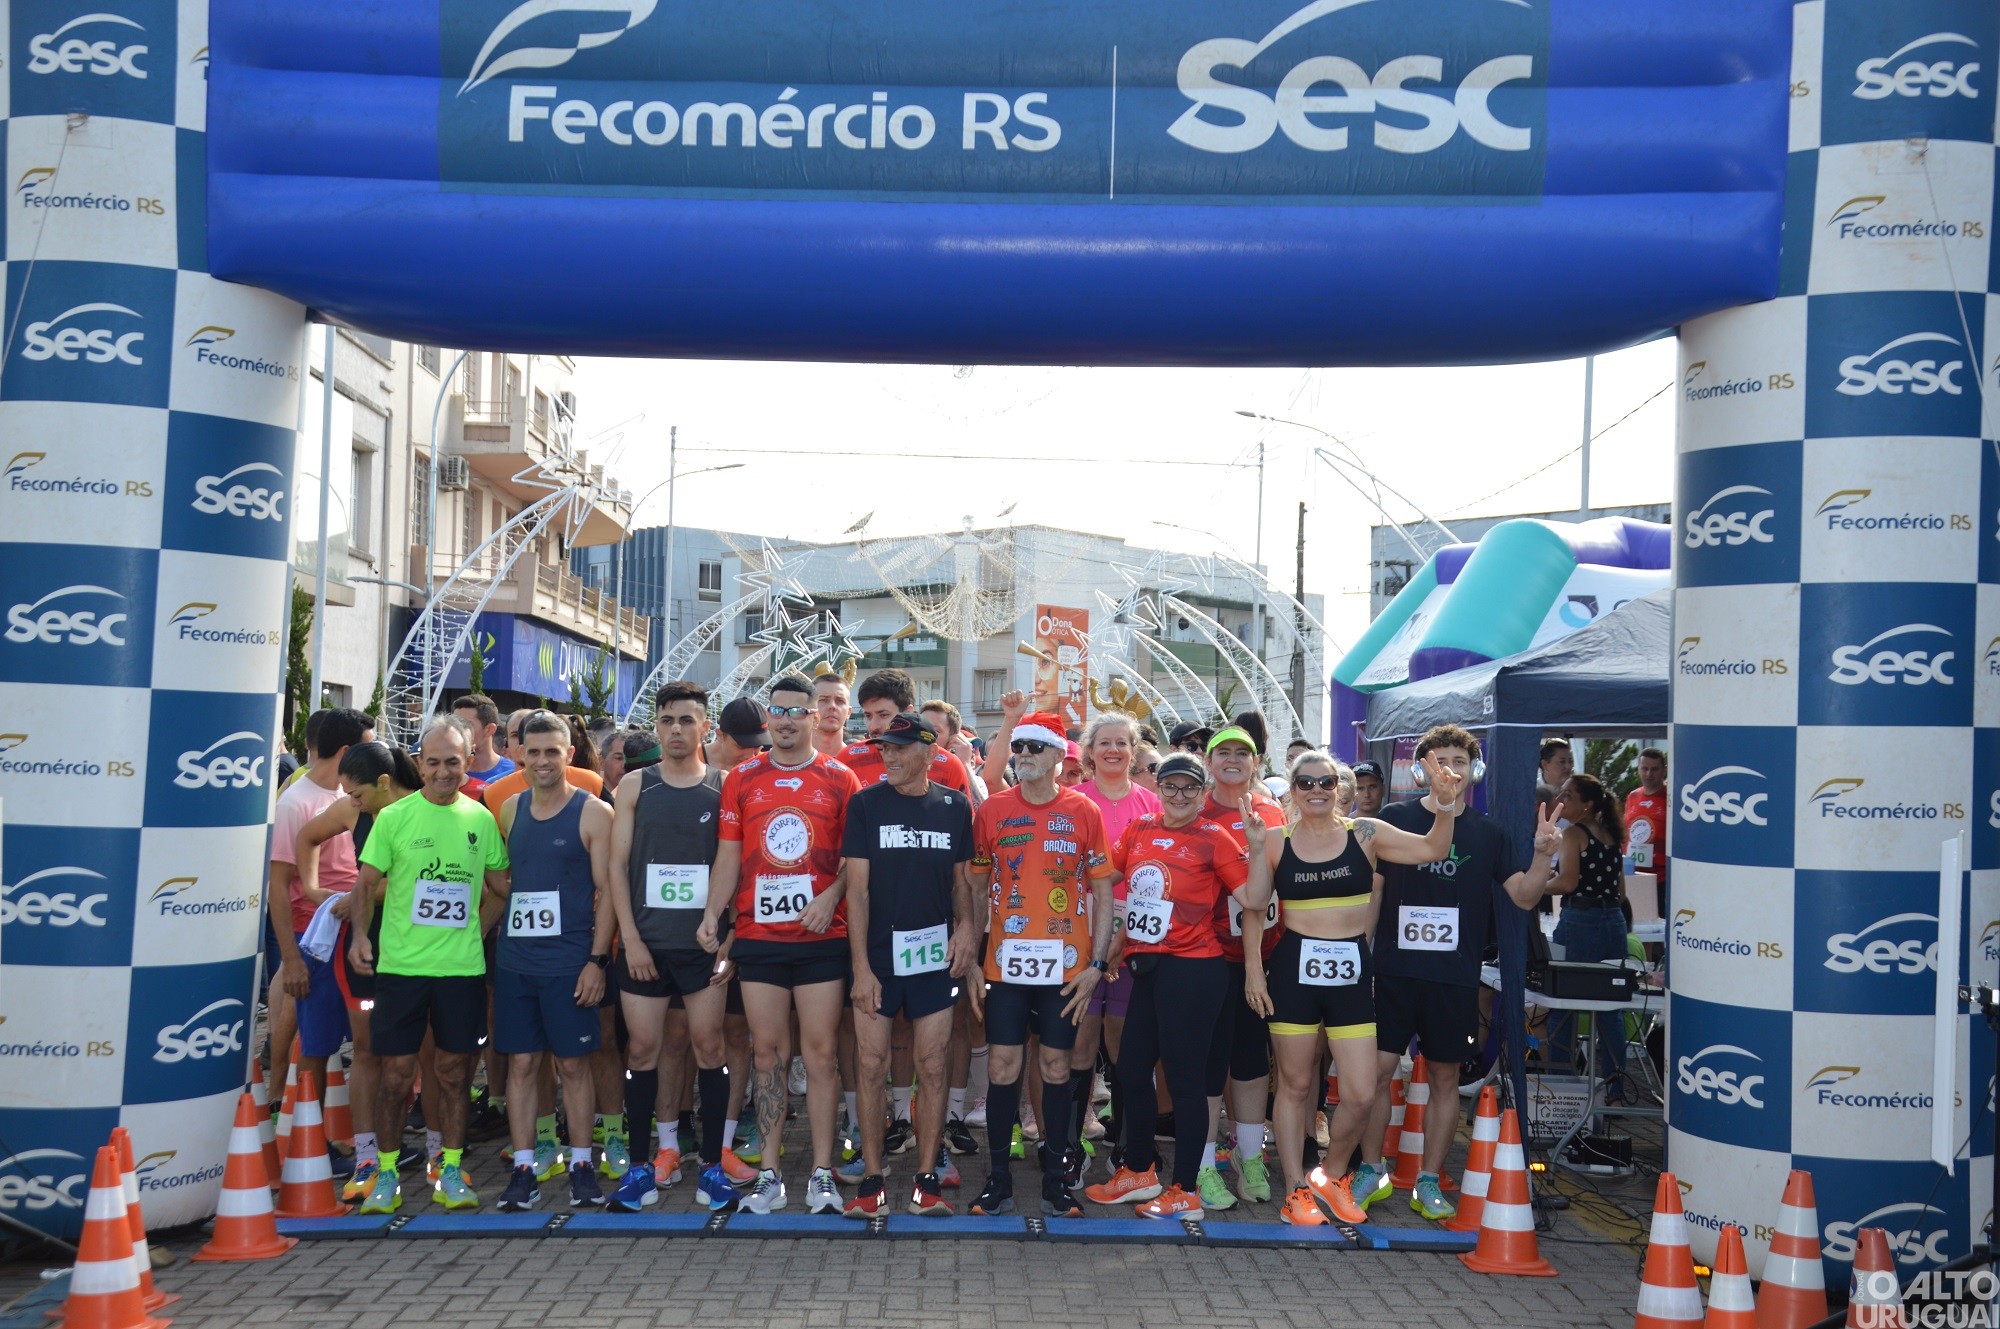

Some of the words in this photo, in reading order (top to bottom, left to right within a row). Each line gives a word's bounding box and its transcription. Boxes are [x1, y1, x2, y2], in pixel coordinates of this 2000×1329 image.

[508, 84, 936, 151] Fecomércio
[962, 91, 1062, 152] RS
[24, 192, 131, 212] Fecomércio
[137, 197, 165, 216] RS
[1840, 220, 1957, 240] Fecomércio
[1962, 221, 1984, 239] RS
[197, 347, 285, 379] Fecomércio
[287, 365, 300, 382] RS
[1685, 376, 1763, 402] Fecomércio
[1768, 373, 1795, 391] RS
[11, 476, 119, 496] Fecomércio
[125, 480, 153, 498] RS
[1827, 512, 1945, 532] Fecomércio
[1950, 515, 1972, 531] RS
[1052, 616, 1073, 628] Dona
[180, 625, 266, 646] Fecomércio
[269, 631, 280, 646] RS
[1680, 656, 1756, 676] Fecomércio
[1762, 659, 1788, 675] RS
[107, 761, 135, 777] RS
[1821, 801, 1937, 820] Fecomércio
[1943, 804, 1965, 820] RS
[880, 824, 904, 833] REDE
[880, 830, 951, 850] MESTRE
[1294, 872, 1319, 883] RUN
[660, 881, 694, 902] 65
[161, 898, 246, 917] Fecomércio
[249, 896, 260, 911] RS
[417, 898, 467, 921] 523
[760, 893, 808, 916] 540
[512, 908, 555, 930] 619
[1127, 910, 1163, 936] 643
[1404, 922, 1453, 944] 662
[900, 941, 945, 969] 115
[1675, 930, 1751, 956] Fecomércio
[1757, 941, 1783, 959] RS
[1006, 957, 1058, 978] 537
[1305, 958, 1356, 980] 633
[0, 1040, 80, 1058] omércio
[86, 1040, 114, 1057] RS
[1818, 1085, 1934, 1109] Fecomércio
[139, 1163, 224, 1192] Fecomércio
[0, 1173, 86, 1210] esc
[1171, 1200, 1190, 1213] FILA
